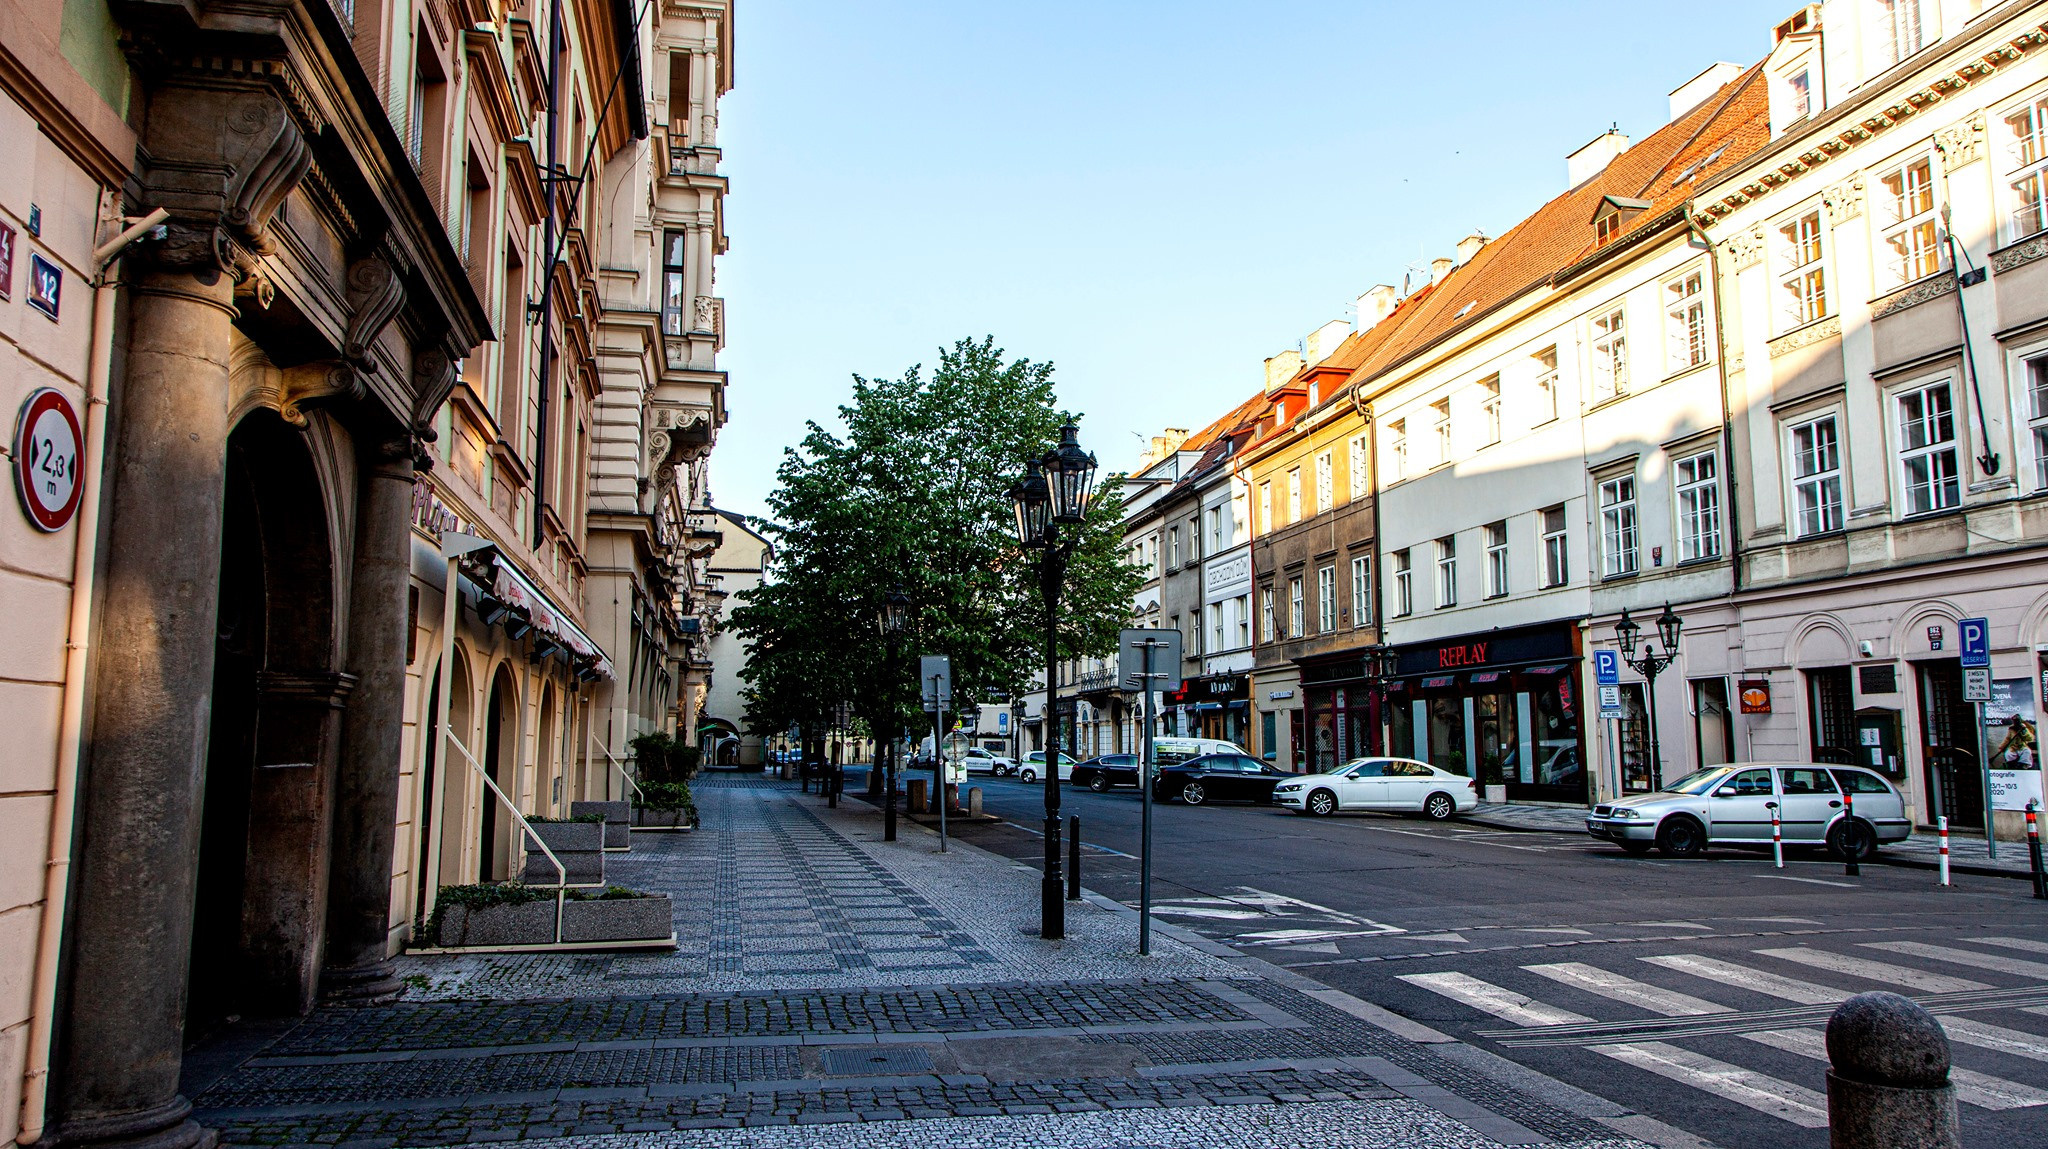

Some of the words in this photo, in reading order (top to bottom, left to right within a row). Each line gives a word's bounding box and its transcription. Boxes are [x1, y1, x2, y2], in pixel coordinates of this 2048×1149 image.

[41, 271, 57, 305] 12
[42, 438, 65, 478] 2,3
[47, 480, 57, 496] m
[1965, 625, 1981, 652] P
[1439, 642, 1488, 668] REPLAY
[1600, 655, 1612, 674] P
